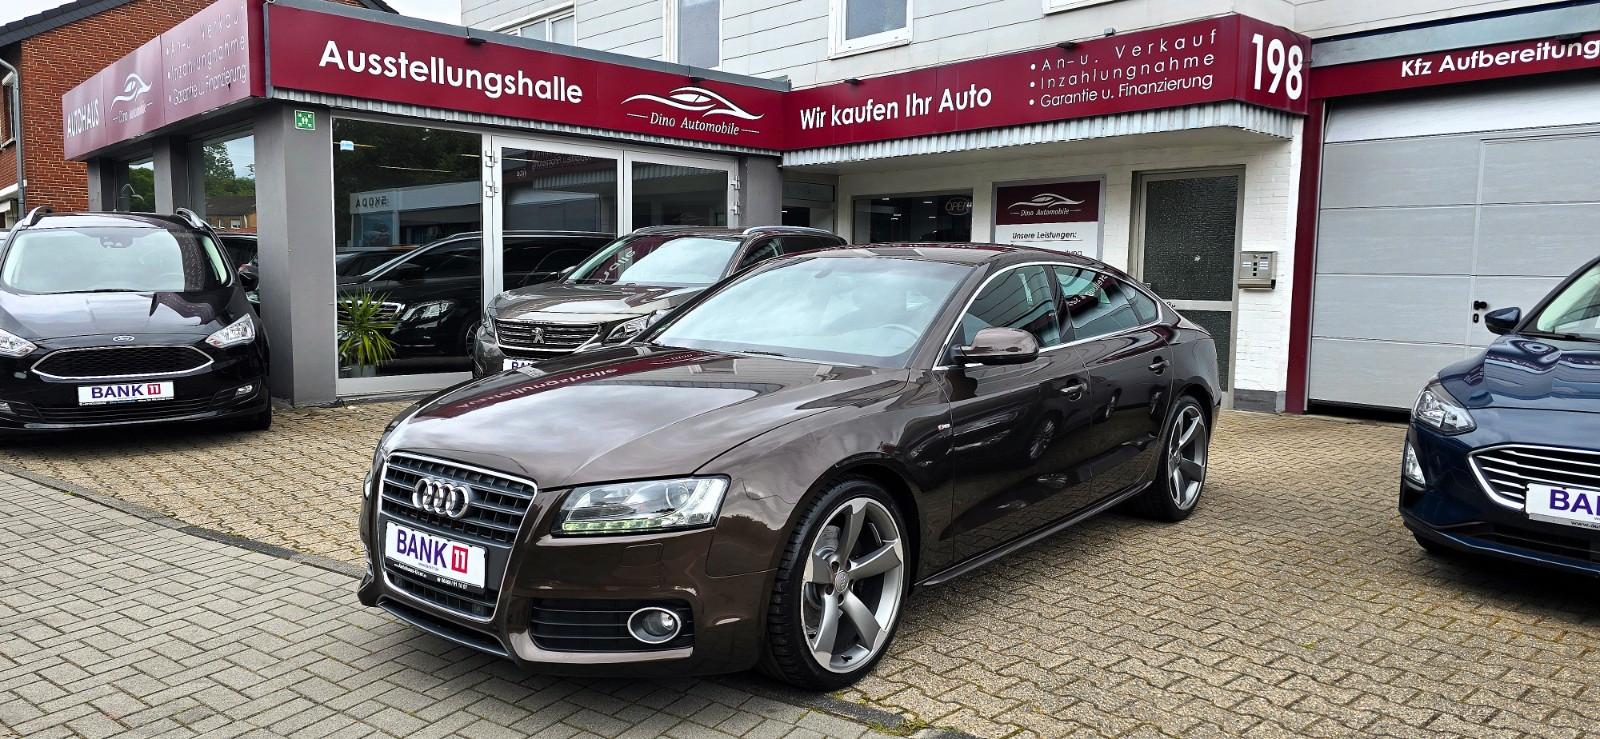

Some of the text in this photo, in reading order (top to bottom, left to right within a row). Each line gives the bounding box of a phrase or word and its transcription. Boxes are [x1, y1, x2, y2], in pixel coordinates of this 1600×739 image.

[1115, 29, 1217, 59] Verkauf
[1400, 39, 1600, 78] Kfz Aufbereitung
[318, 40, 583, 104] Ausstellungshalle
[1040, 53, 1215, 89] Inzahlungnahme
[1251, 33, 1303, 100] 198
[799, 84, 992, 130] Wir kaufen Ihr Auto
[1040, 74, 1214, 107] Garantie u. Finanzierung
[67, 98, 100, 139] AUTOHAUS
[650, 112, 740, 135] Dino Automobile
[1012, 232, 1035, 240] Unsere
[91, 384, 160, 399] BANK 11
[397, 528, 448, 568] BANK
[453, 548, 467, 571] 11
